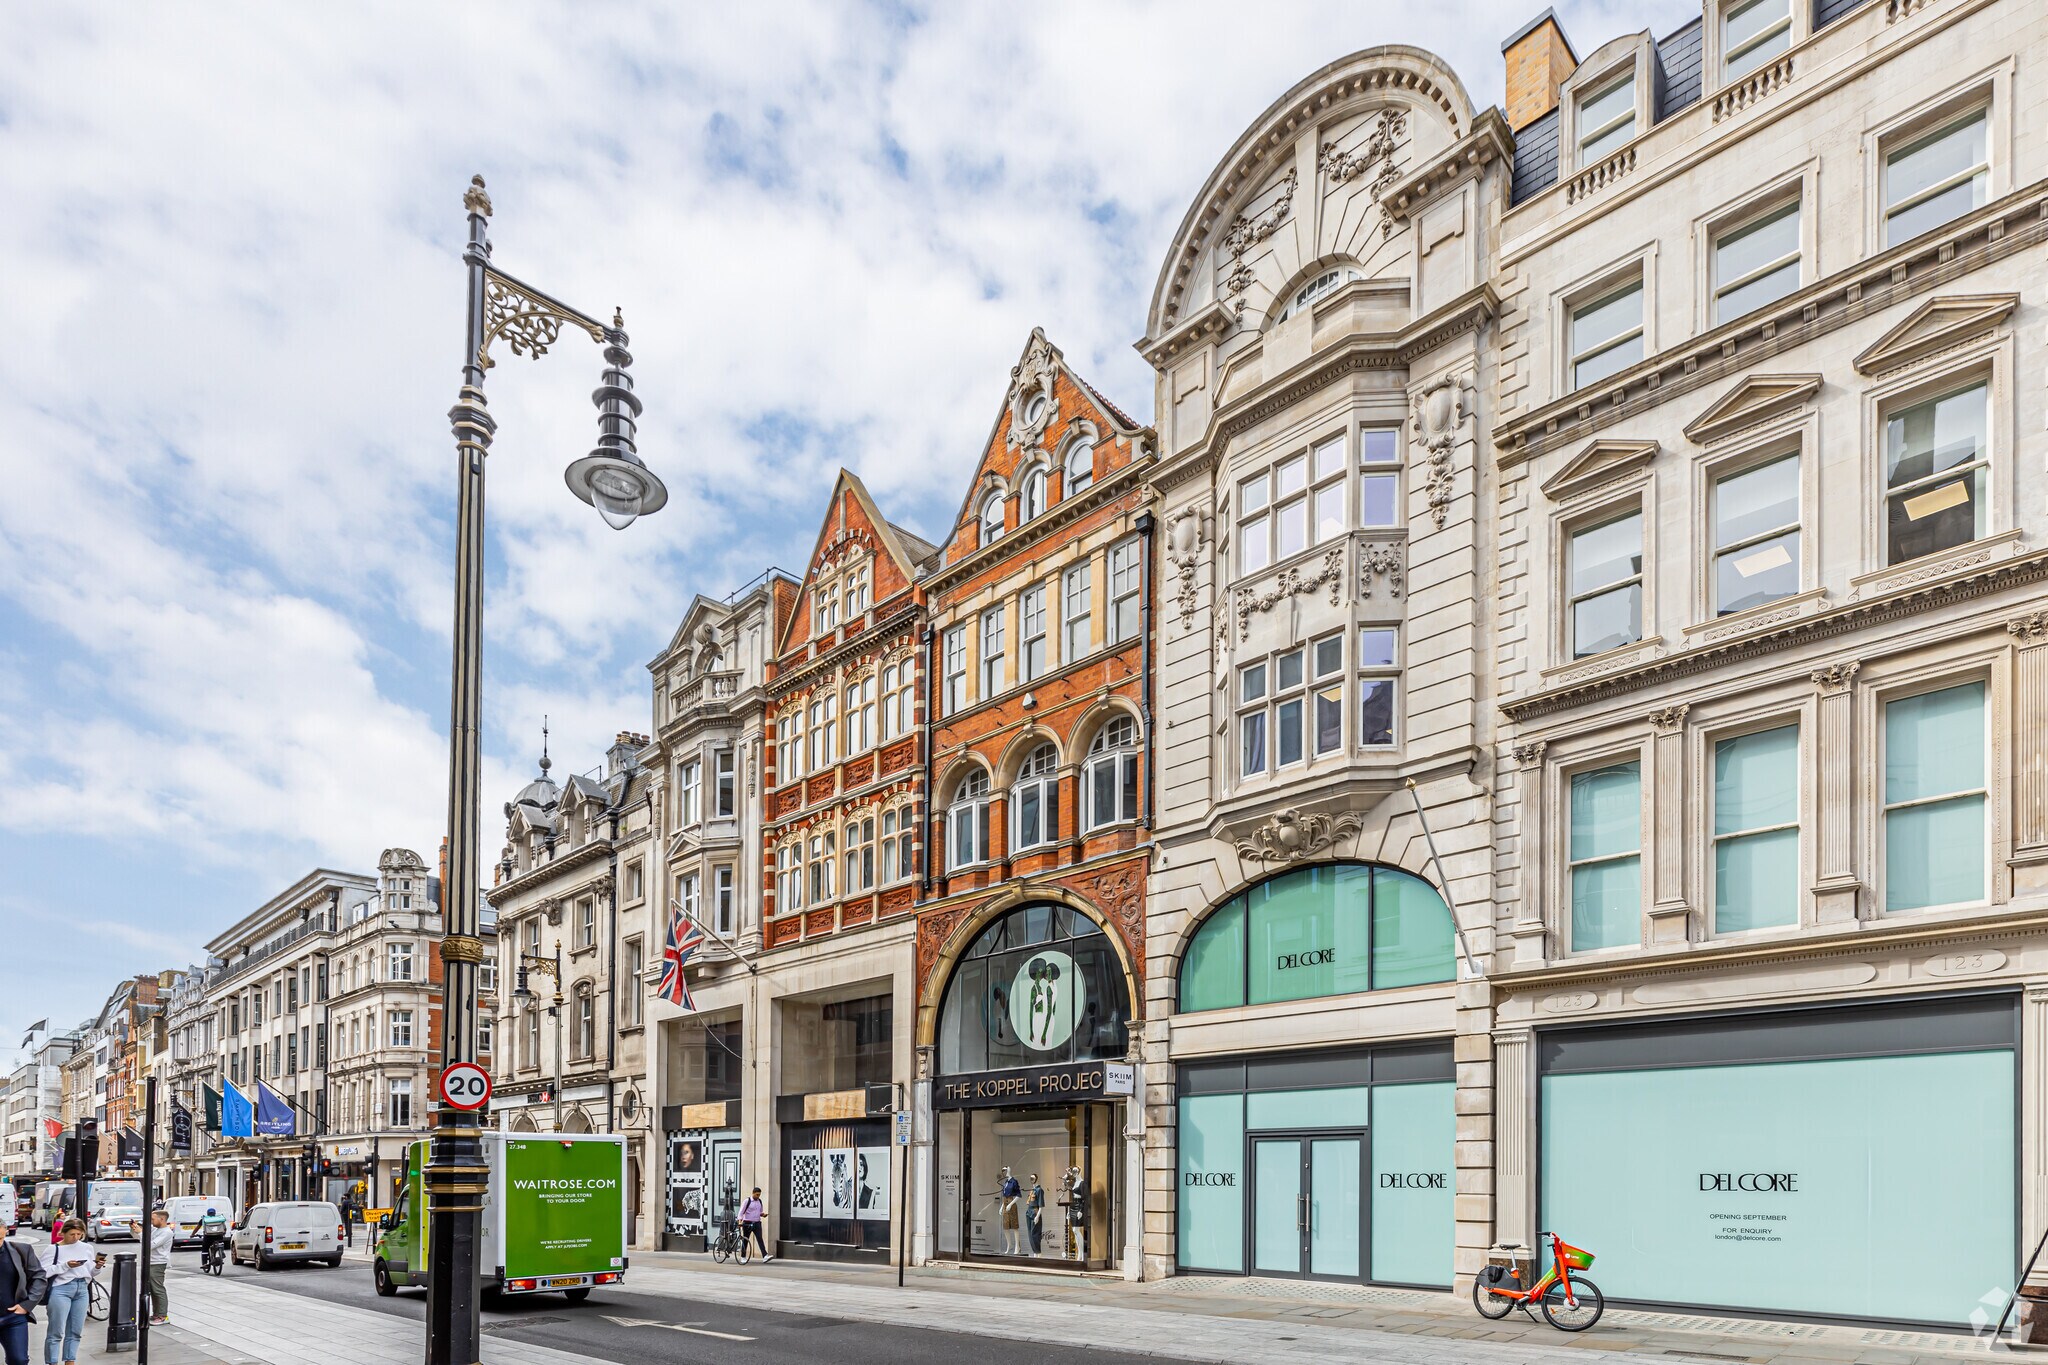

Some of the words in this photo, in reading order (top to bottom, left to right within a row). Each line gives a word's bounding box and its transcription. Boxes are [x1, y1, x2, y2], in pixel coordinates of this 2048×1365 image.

[1943, 954, 1983, 971] 123
[1554, 994, 1583, 1008] 123
[1109, 1072, 1132, 1080] SKIIM
[449, 1076, 485, 1096] 20
[945, 1082, 970, 1100] THE
[977, 1078, 1032, 1098] KOPPEL
[1040, 1071, 1104, 1093] PROJEC
[514, 1179, 616, 1190] WAITROSE.COM
[1715, 1234, 1781, 1242] london@delcore.com
